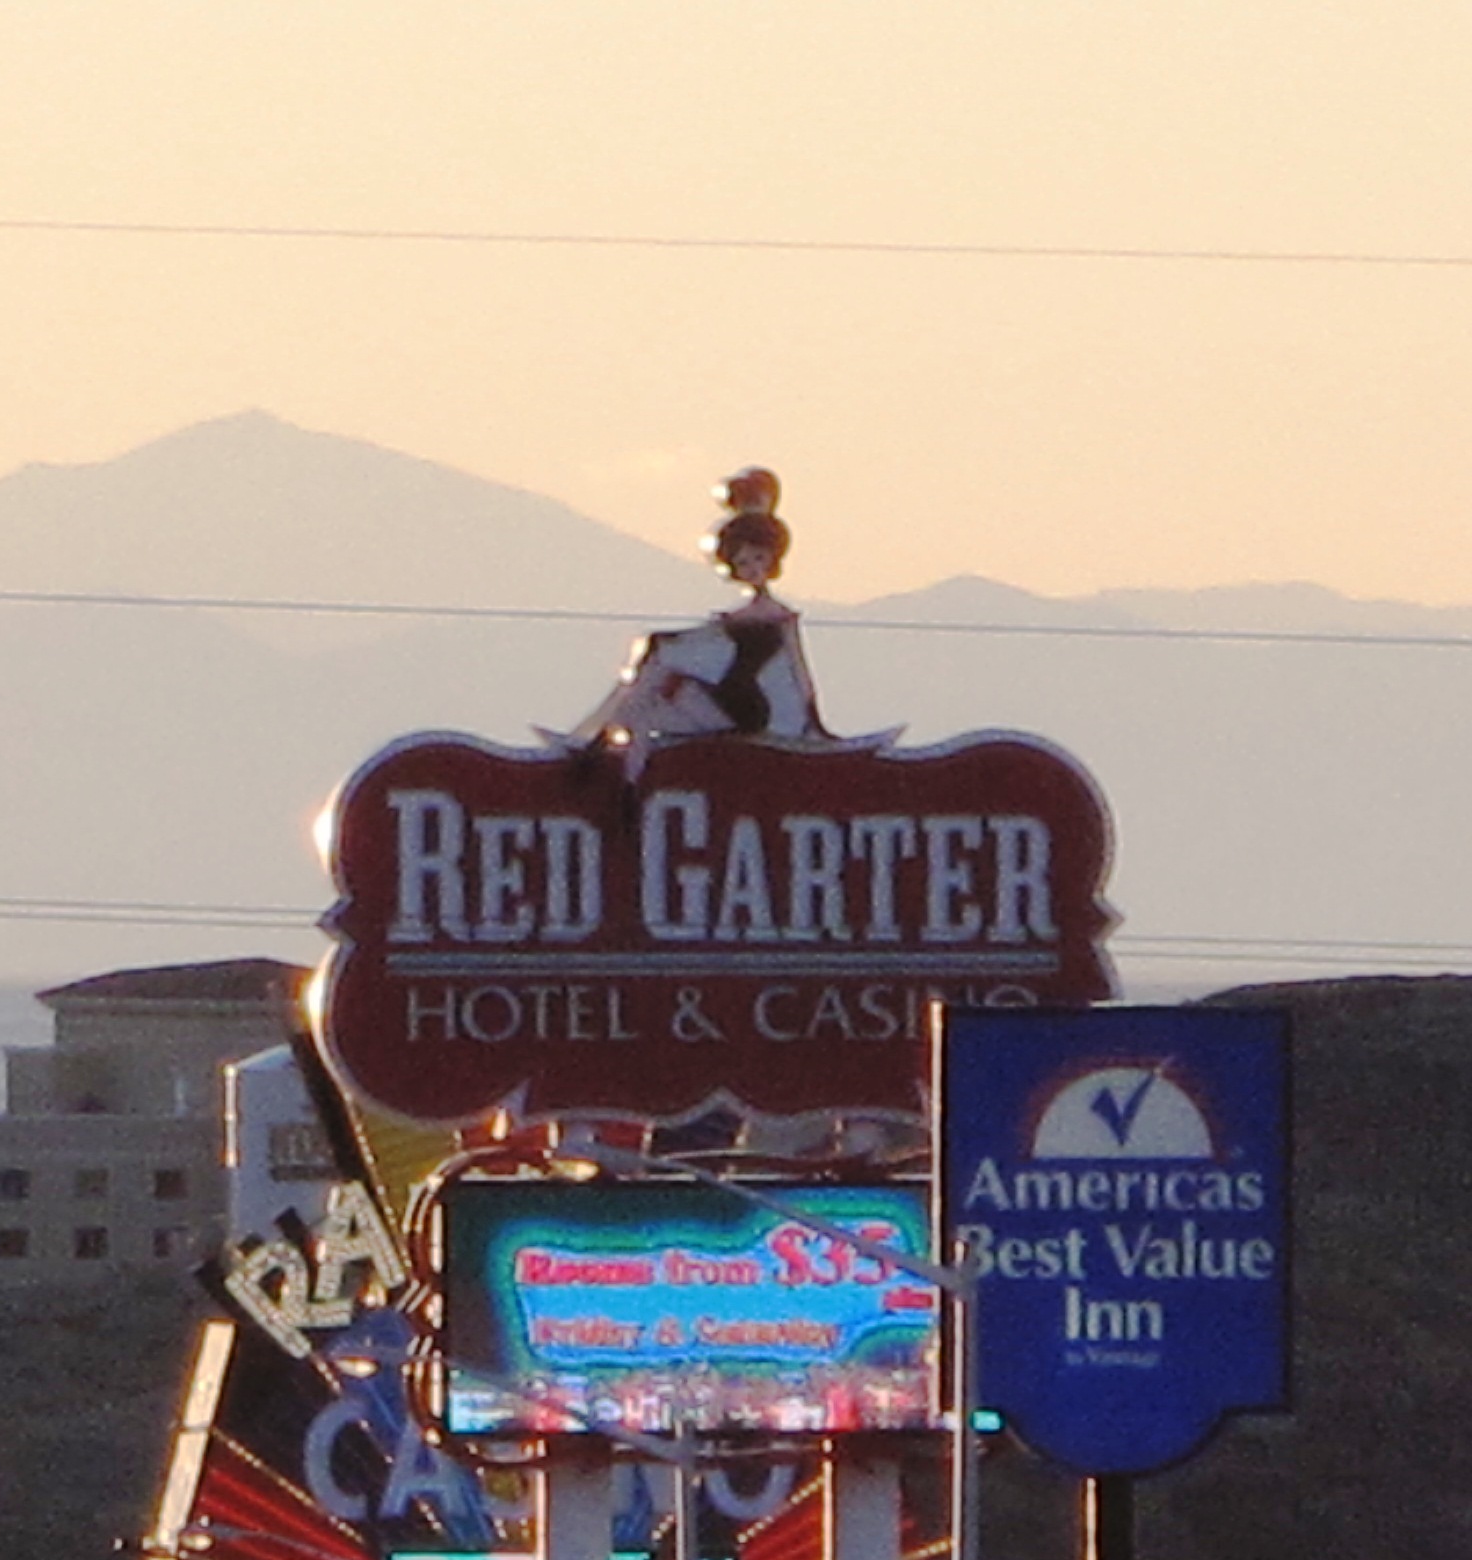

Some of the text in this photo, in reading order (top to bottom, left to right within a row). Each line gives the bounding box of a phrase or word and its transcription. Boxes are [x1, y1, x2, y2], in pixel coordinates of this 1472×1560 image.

[387, 789, 1057, 942] RED GARTER
[406, 986, 638, 1042] HOTEL
[671, 986, 724, 1042] &
[965, 1156, 1264, 1211] Americas
[956, 1225, 1275, 1280] Best Value
[1064, 1285, 1163, 1341] Inn
